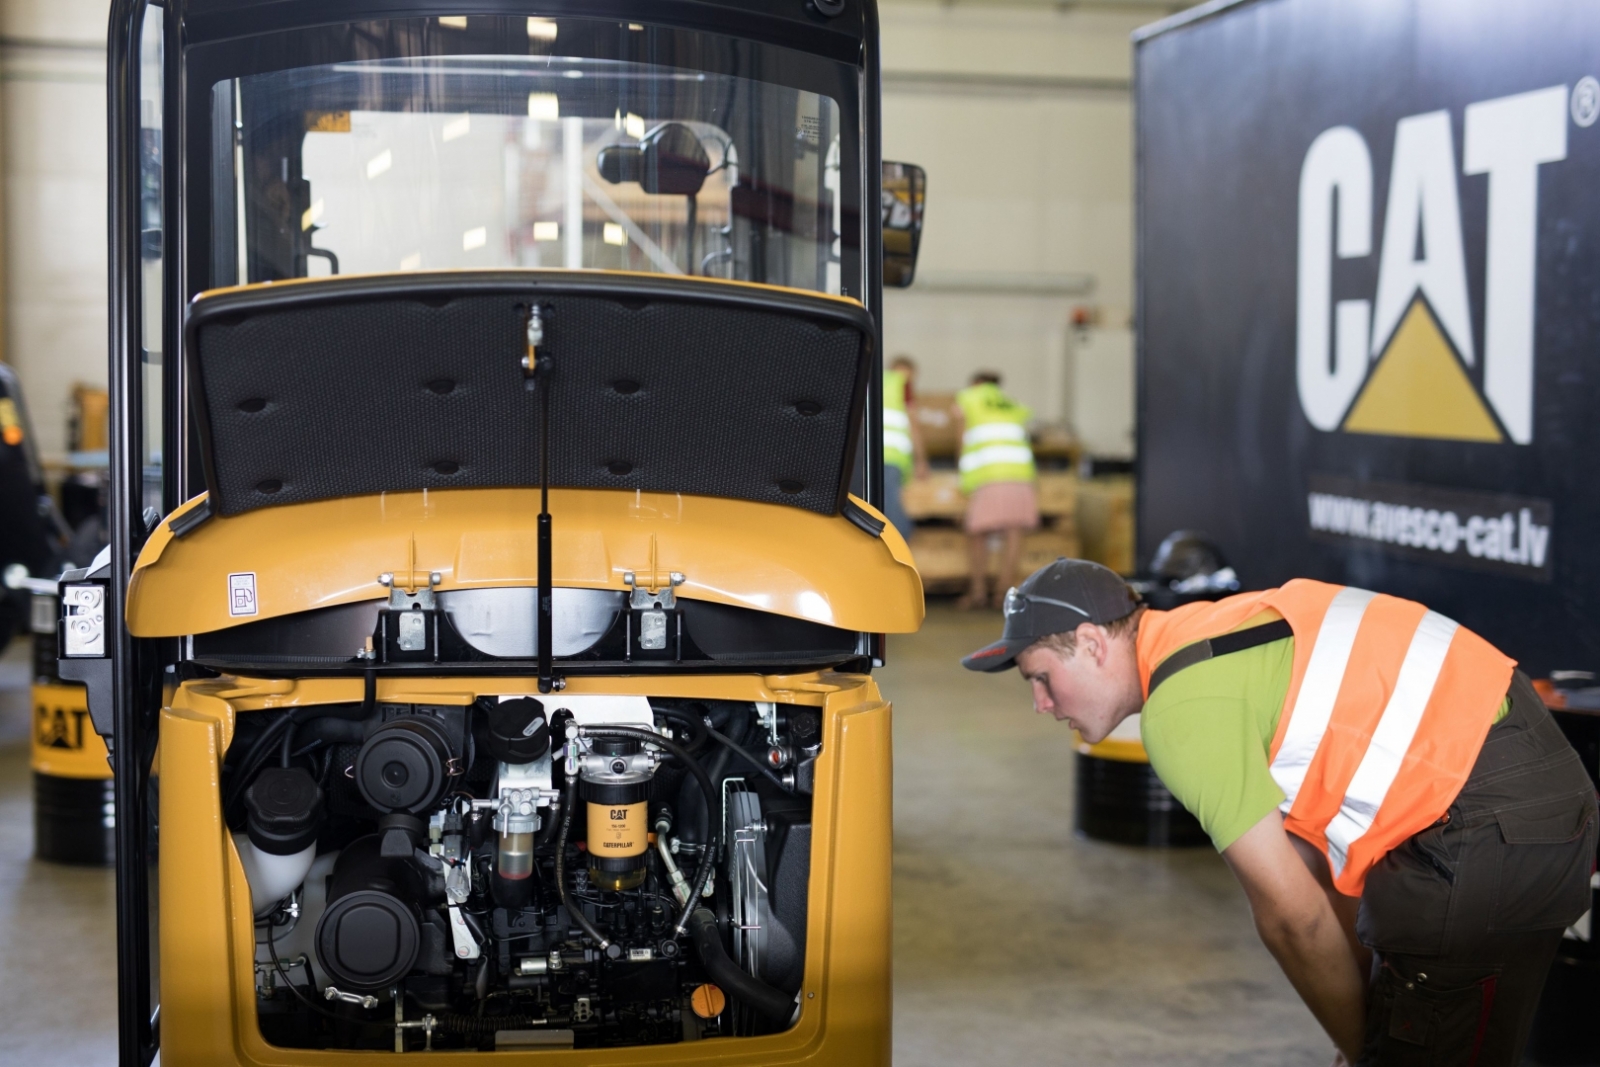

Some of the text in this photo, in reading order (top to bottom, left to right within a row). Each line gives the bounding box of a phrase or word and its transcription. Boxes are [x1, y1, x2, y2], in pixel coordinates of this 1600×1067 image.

[1297, 84, 1568, 446] CAT
[1308, 492, 1550, 568] www.avesco-cat.lv
[36, 703, 88, 749] CAT
[610, 809, 628, 820] CAT
[603, 841, 633, 849] CATERPILLAR
